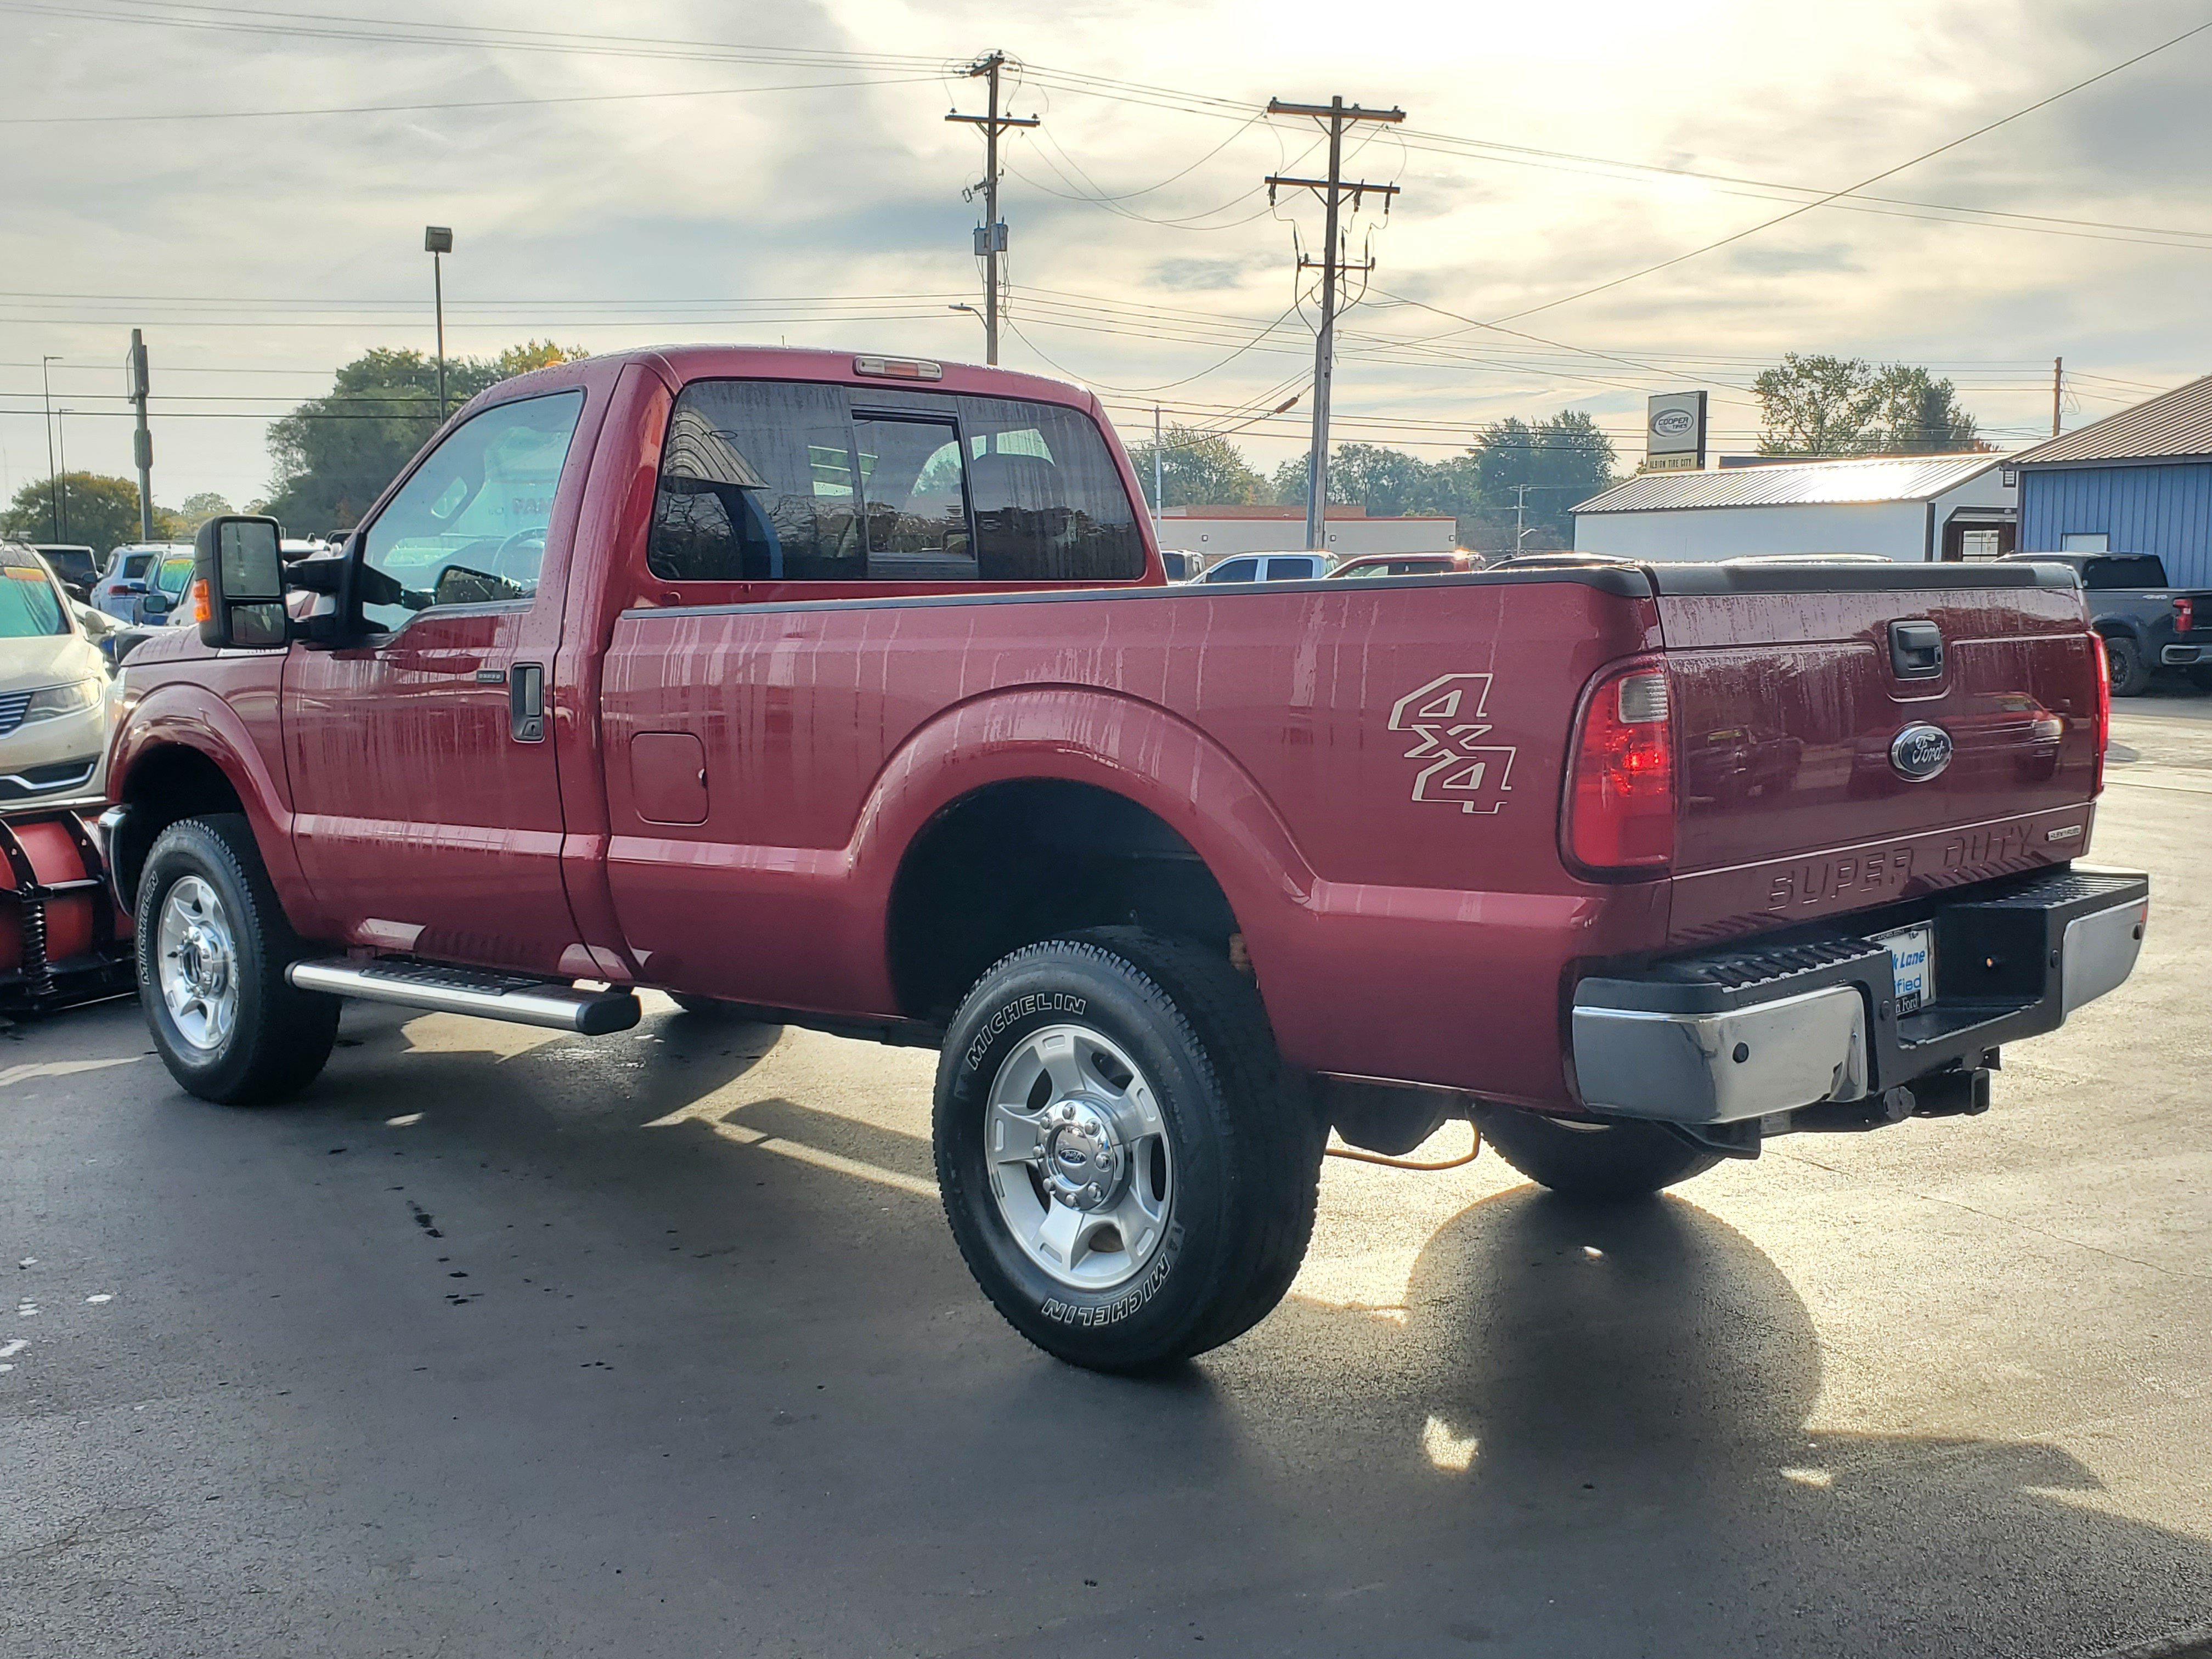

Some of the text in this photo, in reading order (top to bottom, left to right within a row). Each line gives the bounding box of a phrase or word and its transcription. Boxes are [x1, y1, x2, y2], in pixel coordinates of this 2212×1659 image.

[1658, 417, 1689, 426] COOPER
[1649, 458, 1691, 469] ALBION TIRE CITY
[1912, 733, 1945, 765] Ford
[1767, 823, 2033, 911] SUPER DUTY
[138, 870, 159, 985] MICHELIN
[1899, 950, 1925, 969] Lane
[1902, 993, 1918, 1012] Ford
[966, 993, 1087, 1071] MICHELIN
[1041, 1252, 1171, 1327] MICHELIN
